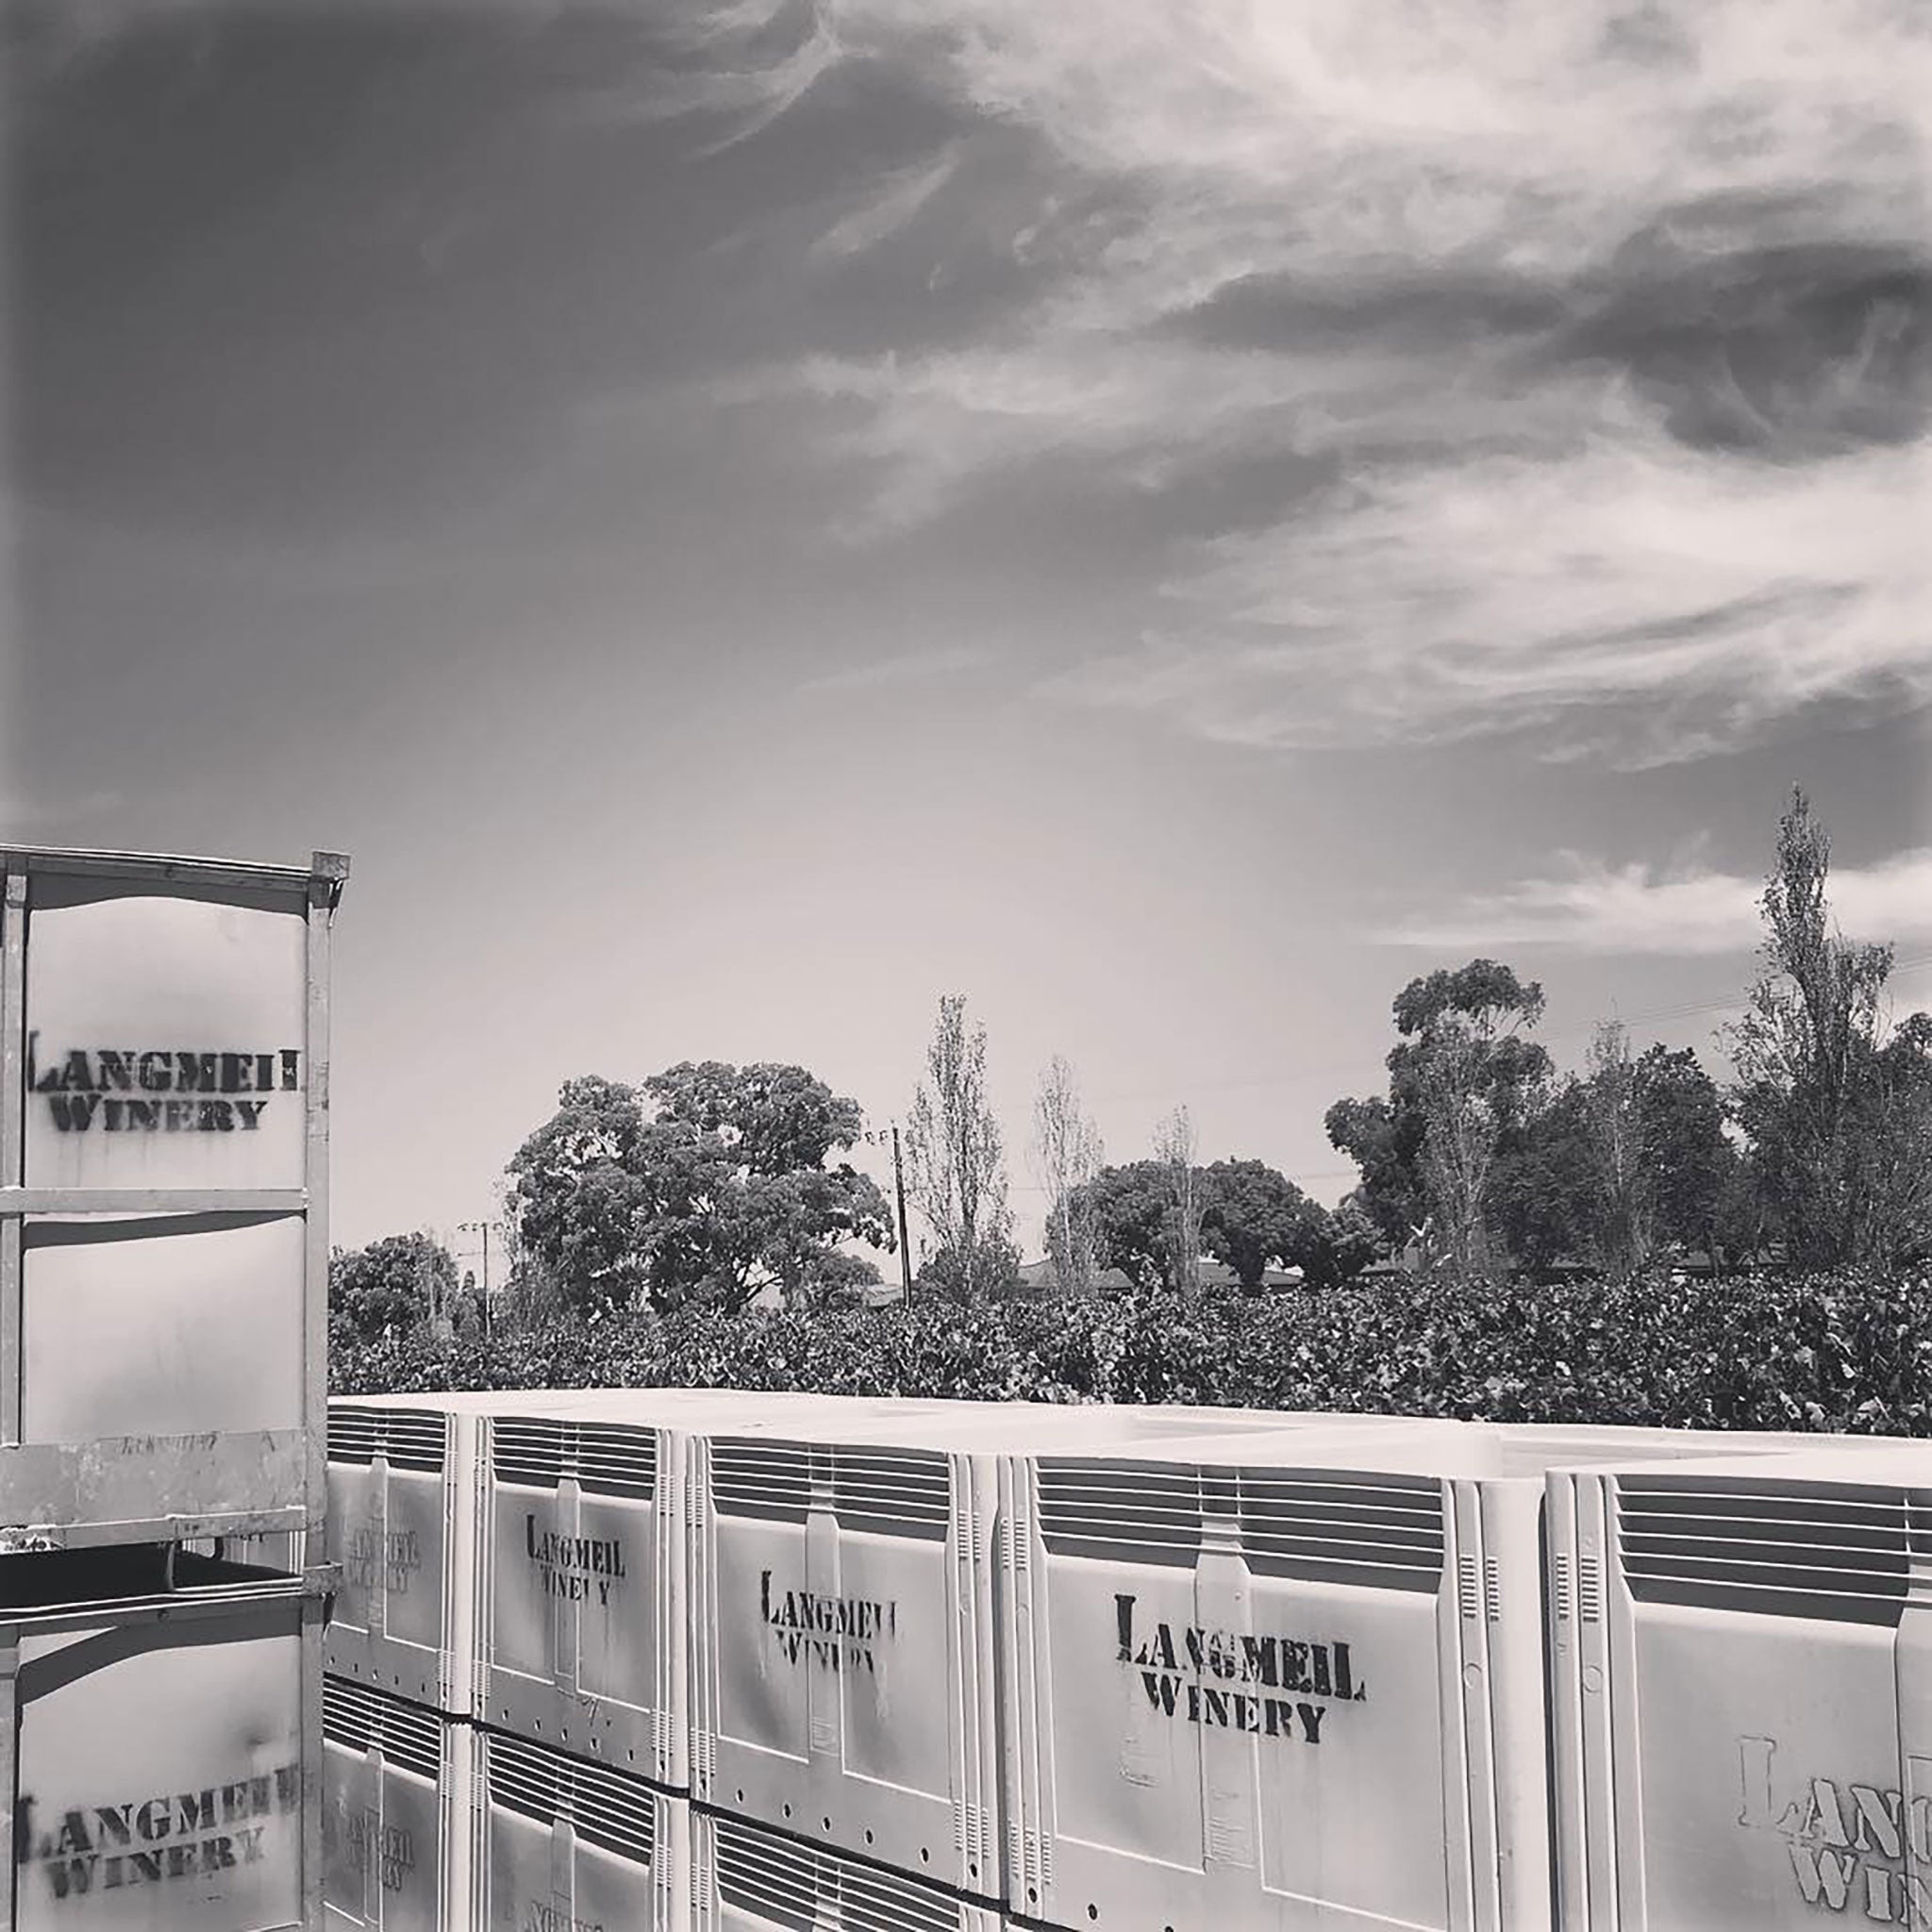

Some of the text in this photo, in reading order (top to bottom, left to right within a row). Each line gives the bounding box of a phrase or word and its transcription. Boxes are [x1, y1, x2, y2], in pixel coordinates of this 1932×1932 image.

[27, 1030, 301, 1092] LANGMEIL
[49, 1093, 268, 1131] WINERY
[526, 1514, 625, 1578] LANGMEIL
[1114, 1594, 1367, 1702] LANGMEIL
[1141, 1671, 1327, 1744] WINERY
[45, 1826, 265, 1898] WINERY
